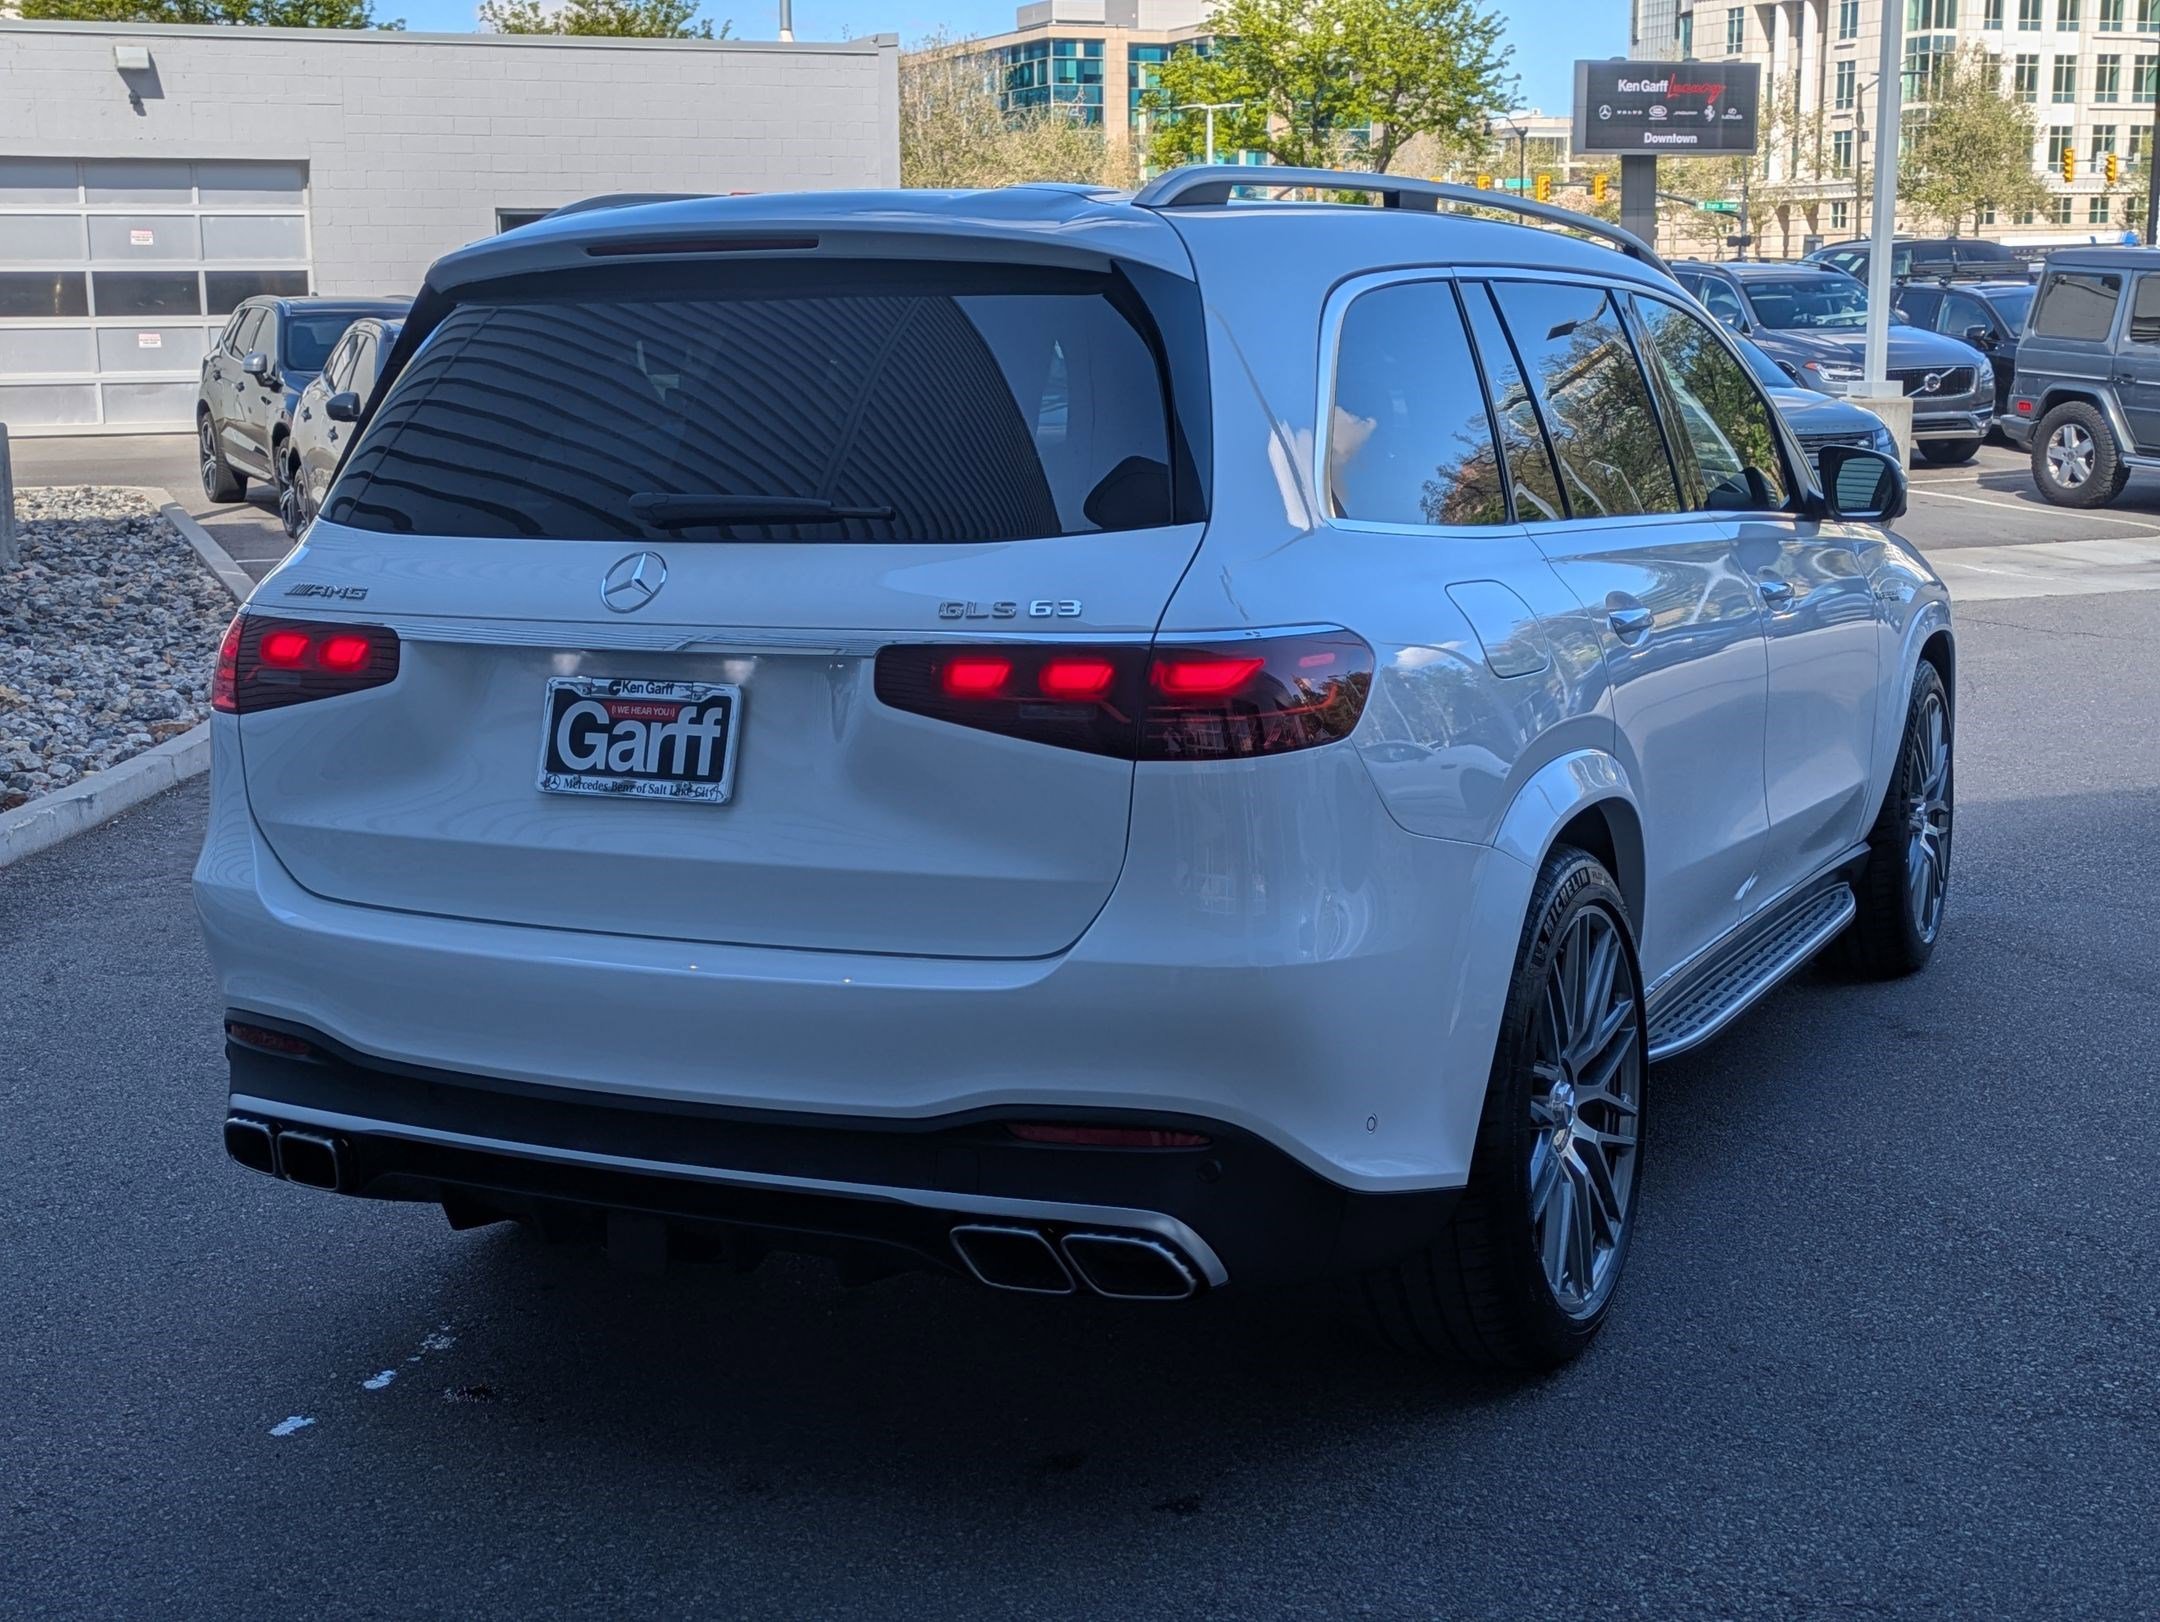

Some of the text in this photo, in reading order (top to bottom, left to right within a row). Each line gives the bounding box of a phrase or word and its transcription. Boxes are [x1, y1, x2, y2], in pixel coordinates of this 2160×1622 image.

[1618, 79, 1640, 92] Ken
[1641, 79, 1669, 92] Garff
[1644, 132, 1698, 144] Downtown
[304, 584, 369, 600] AMG
[939, 600, 1083, 619] GLS 63
[622, 680, 675, 695] Ken Garff
[617, 705, 670, 717] WE HEAR YOU
[557, 700, 723, 776] Garff
[636, 781, 648, 793] of
[649, 782, 667, 795] Salt
[1543, 868, 1590, 938] MICHELIN
